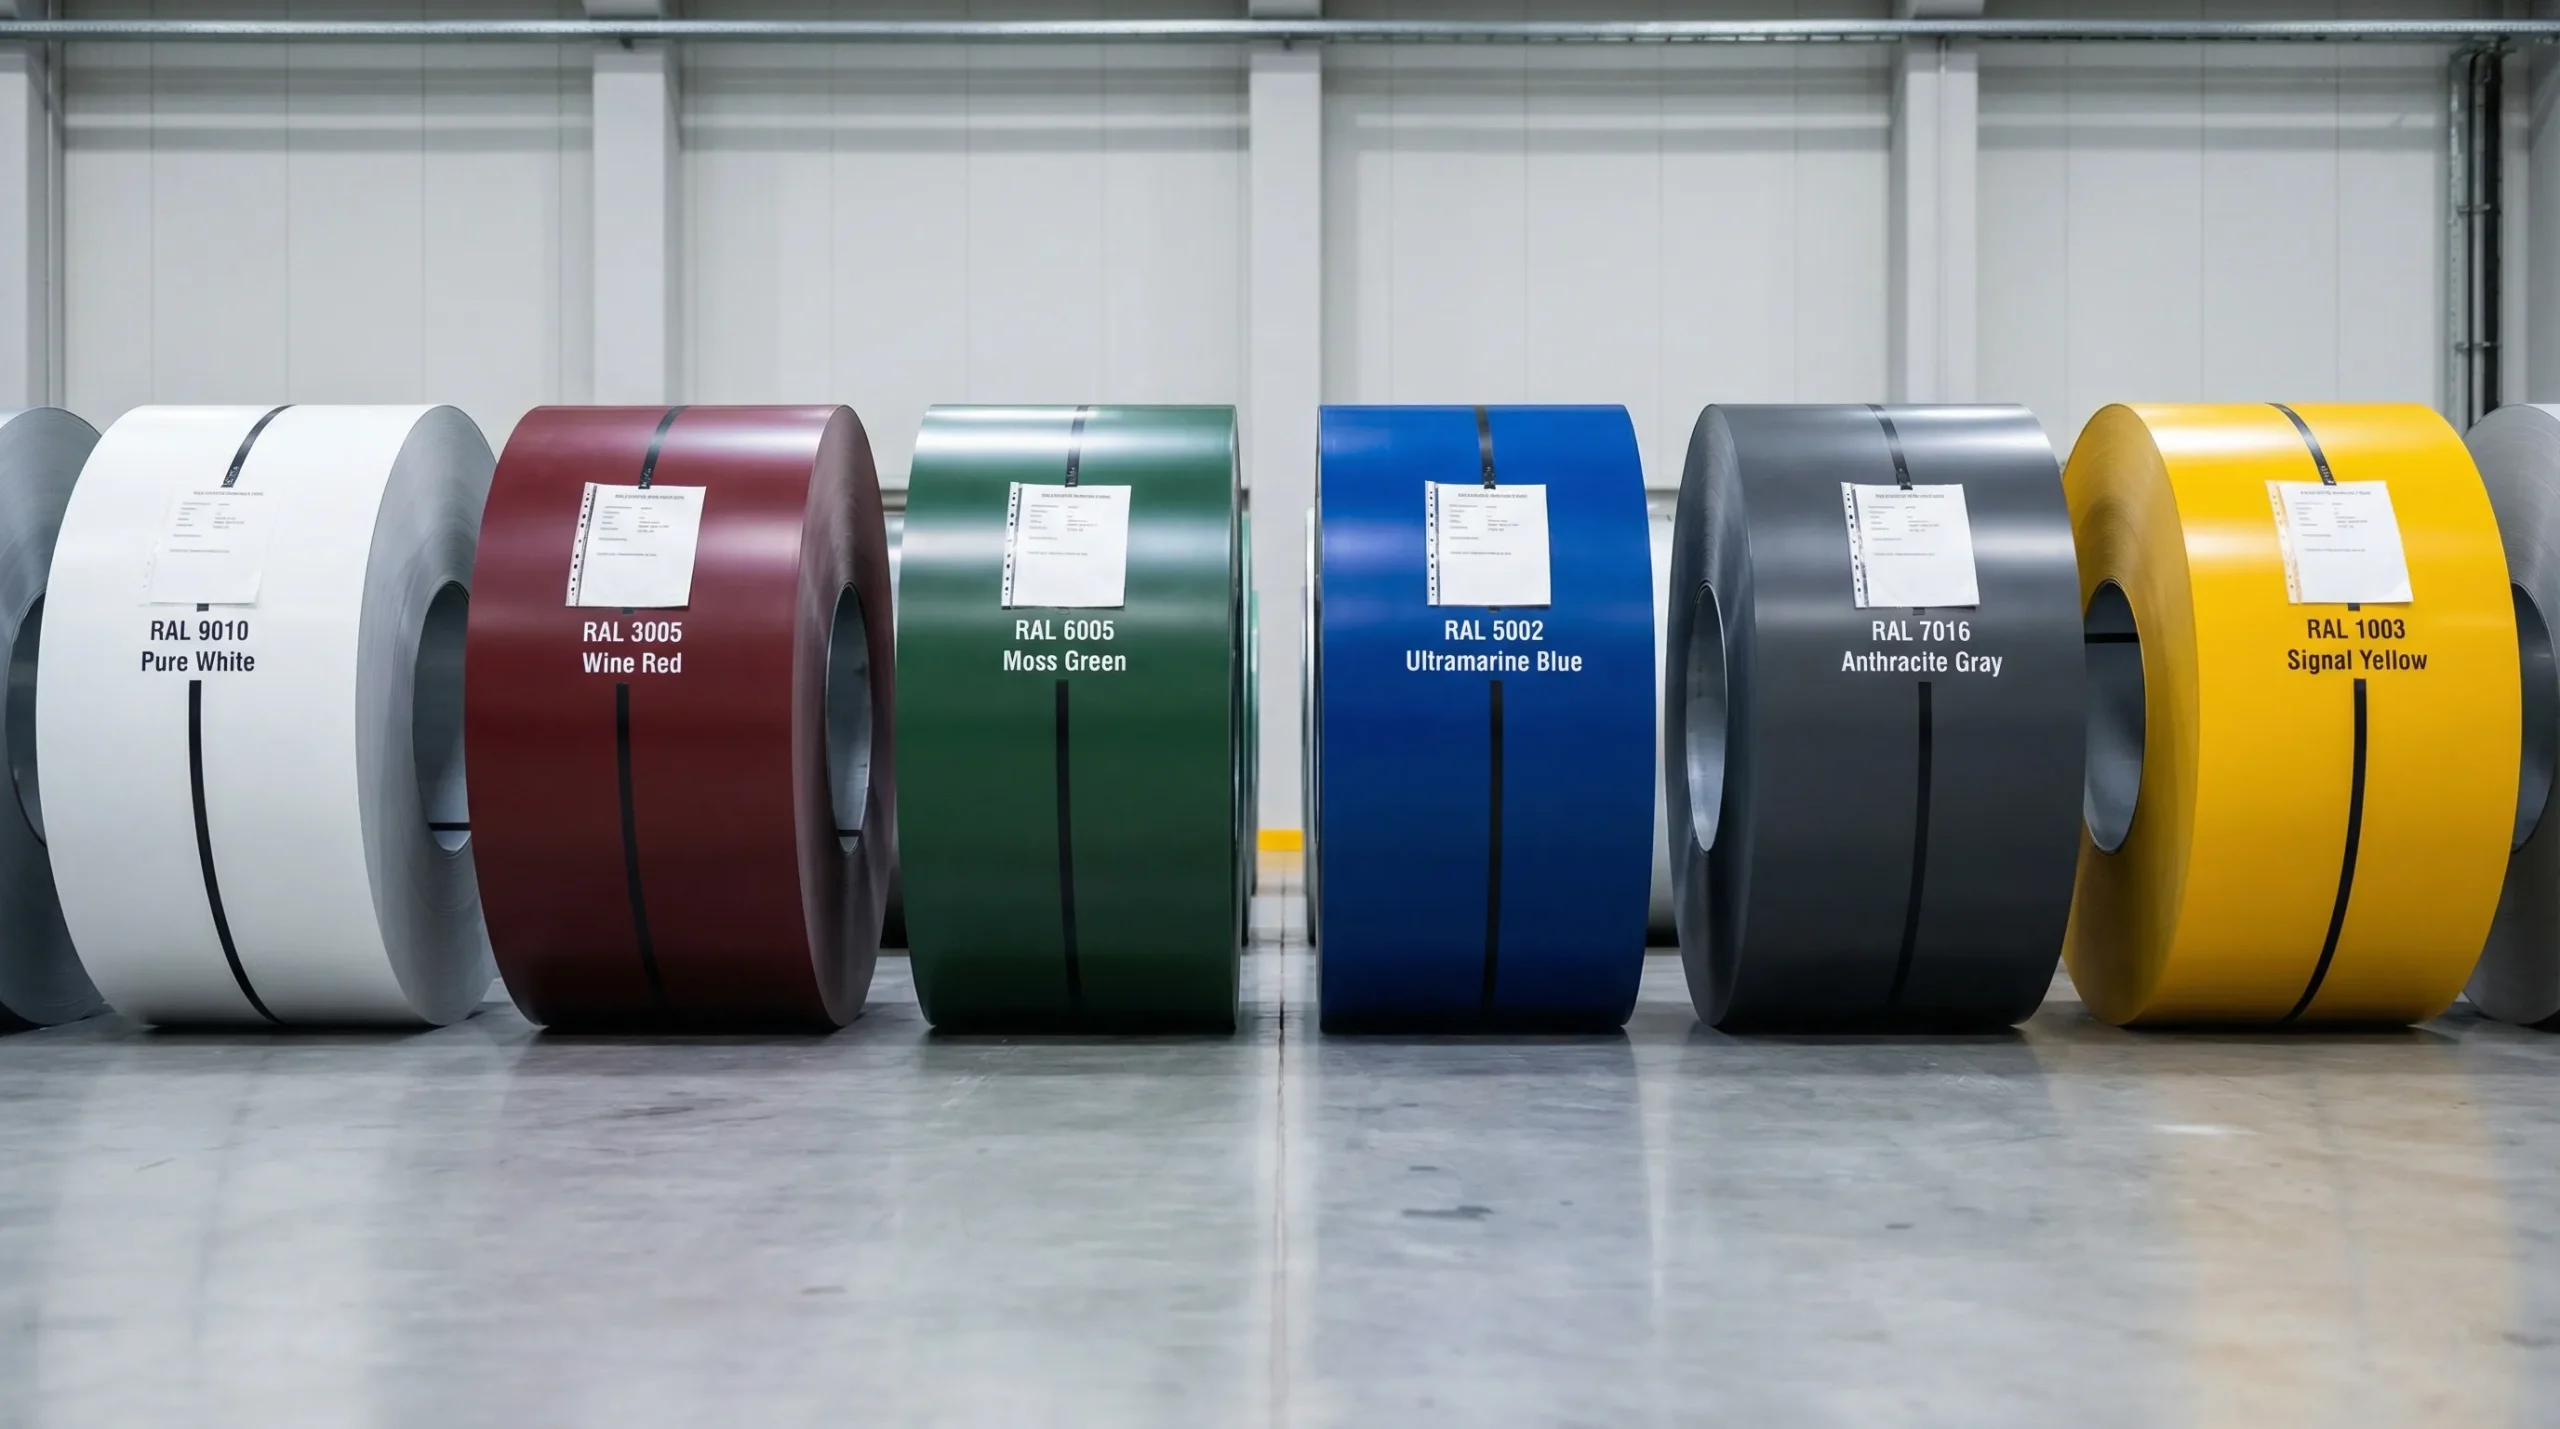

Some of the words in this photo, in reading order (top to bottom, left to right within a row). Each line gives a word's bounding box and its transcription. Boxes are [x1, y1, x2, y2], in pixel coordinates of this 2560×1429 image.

[150, 619, 192, 641] RAL
[198, 620, 249, 641] 9010
[583, 620, 625, 642] RAL
[630, 620, 683, 643] 3005
[1015, 619, 1057, 641] RAL
[1063, 619, 1115, 641] 6005
[1444, 619, 1487, 641] RAL
[1492, 619, 1544, 641] 5002
[1872, 619, 1914, 641] RAL
[1919, 620, 1971, 642] 7016
[2307, 618, 2349, 640] RAL
[2355, 618, 2406, 640] 1003
[141, 650, 189, 673] Pure
[195, 650, 255, 672] White
[582, 651, 635, 674] Wine
[642, 652, 682, 674] Red
[1003, 649, 1058, 672] Moss
[1064, 649, 1127, 672] Green
[1406, 649, 1530, 672] Ultramarine
[1537, 650, 1583, 672] Blue
[1841, 650, 1948, 673] Anthracite
[1955, 650, 2003, 678] Gray
[2287, 648, 2353, 675] Signal
[2358, 649, 2428, 671] Yellow
